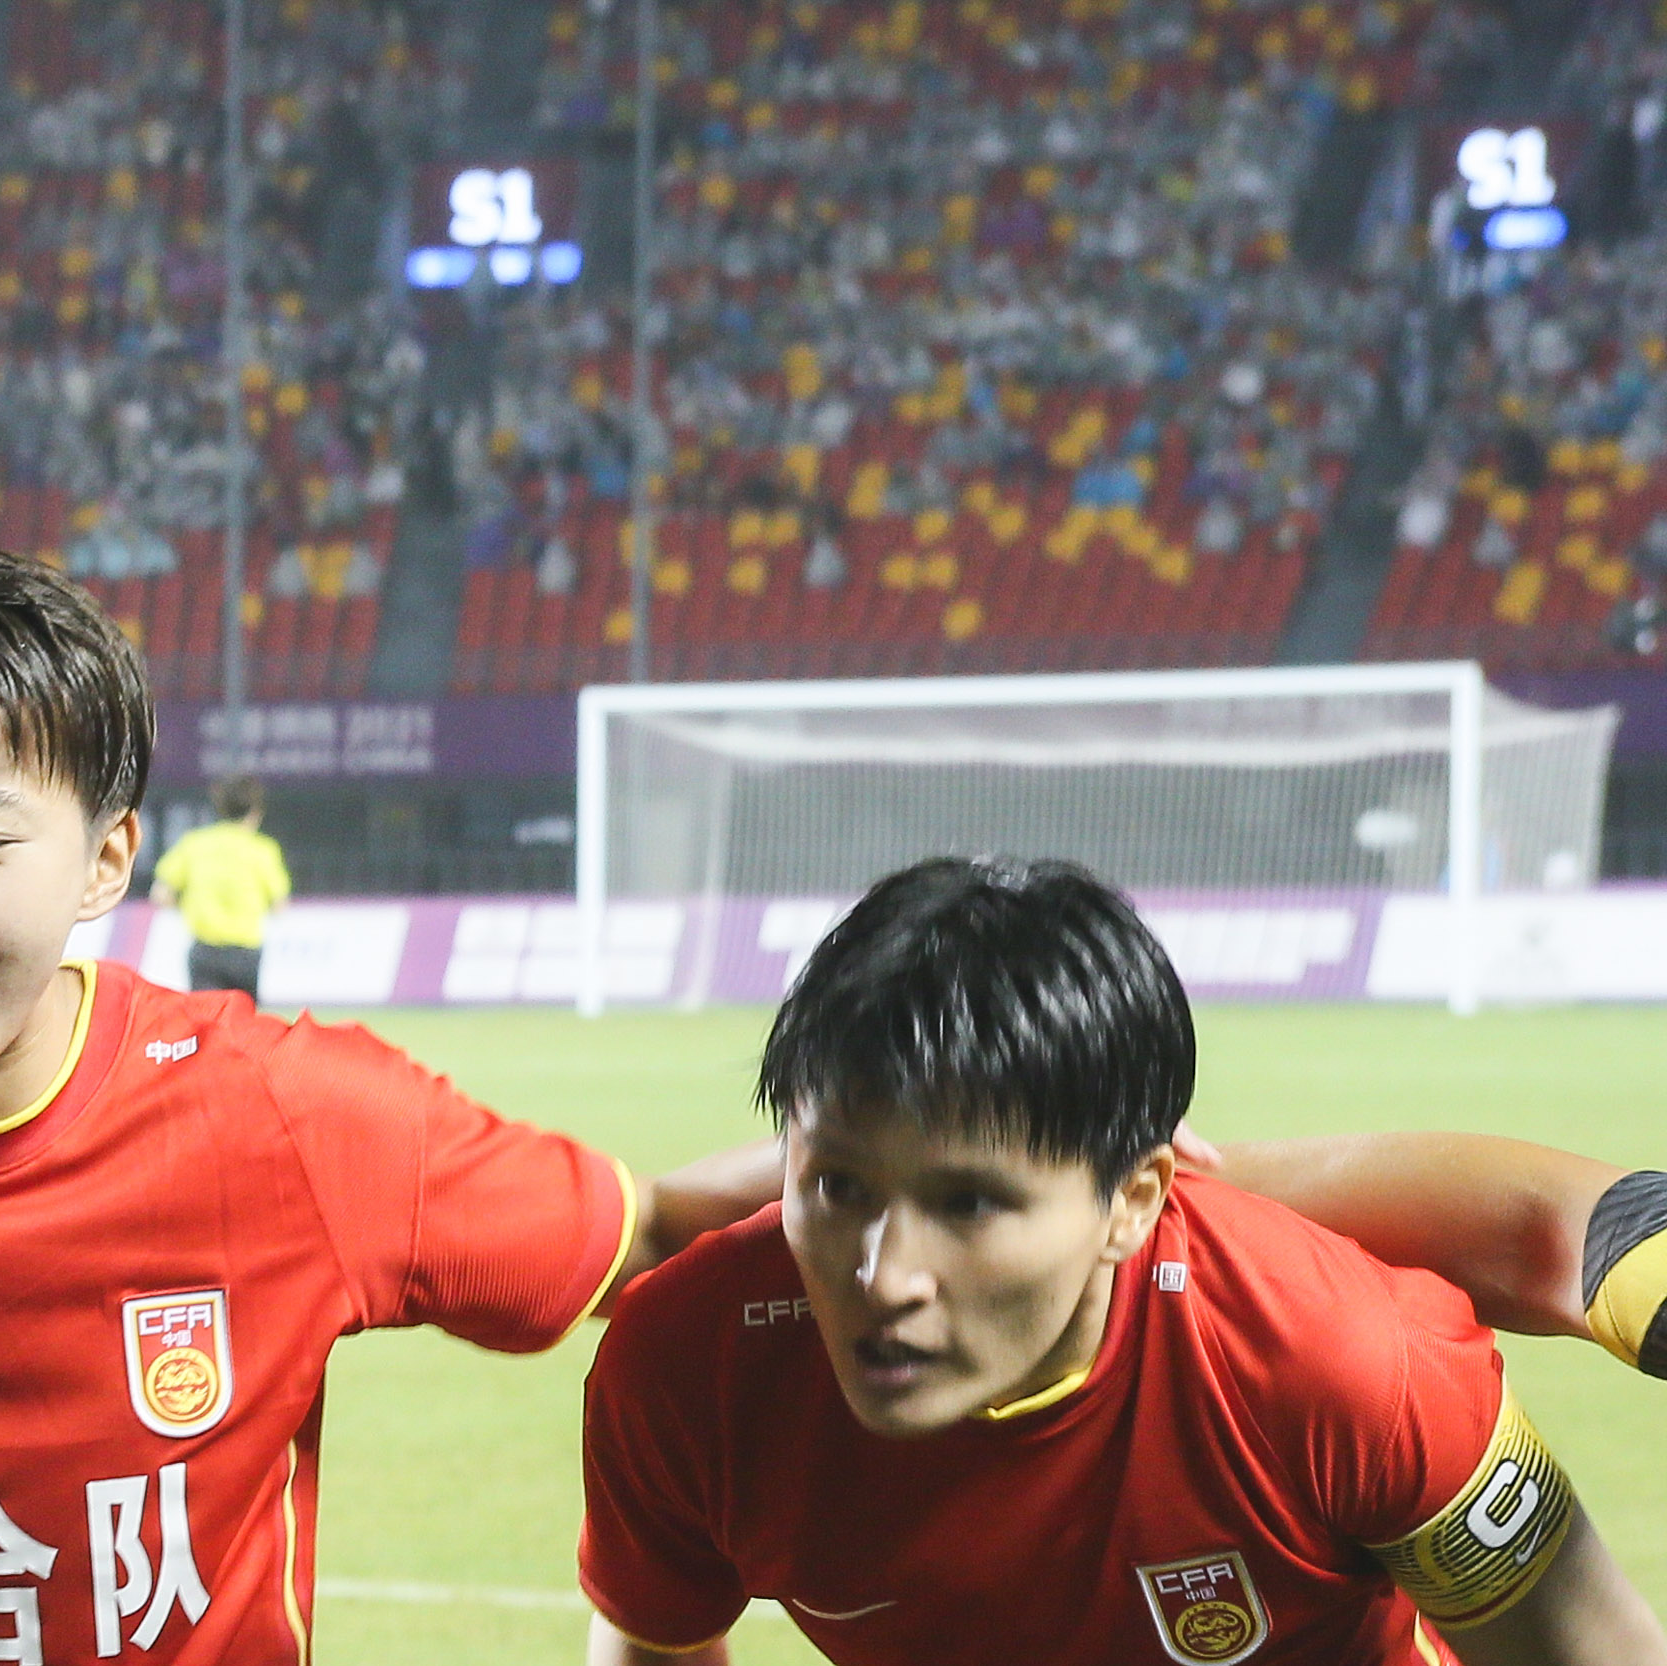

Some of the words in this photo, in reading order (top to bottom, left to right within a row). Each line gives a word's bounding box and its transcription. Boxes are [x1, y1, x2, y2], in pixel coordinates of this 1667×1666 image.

[145, 1035, 198, 1065] 中国
[1153, 1261, 1187, 1292] 国
[138, 1304, 212, 1335] CFA
[1465, 1458, 1540, 1549] C
[1155, 1563, 1234, 1594] CFA
